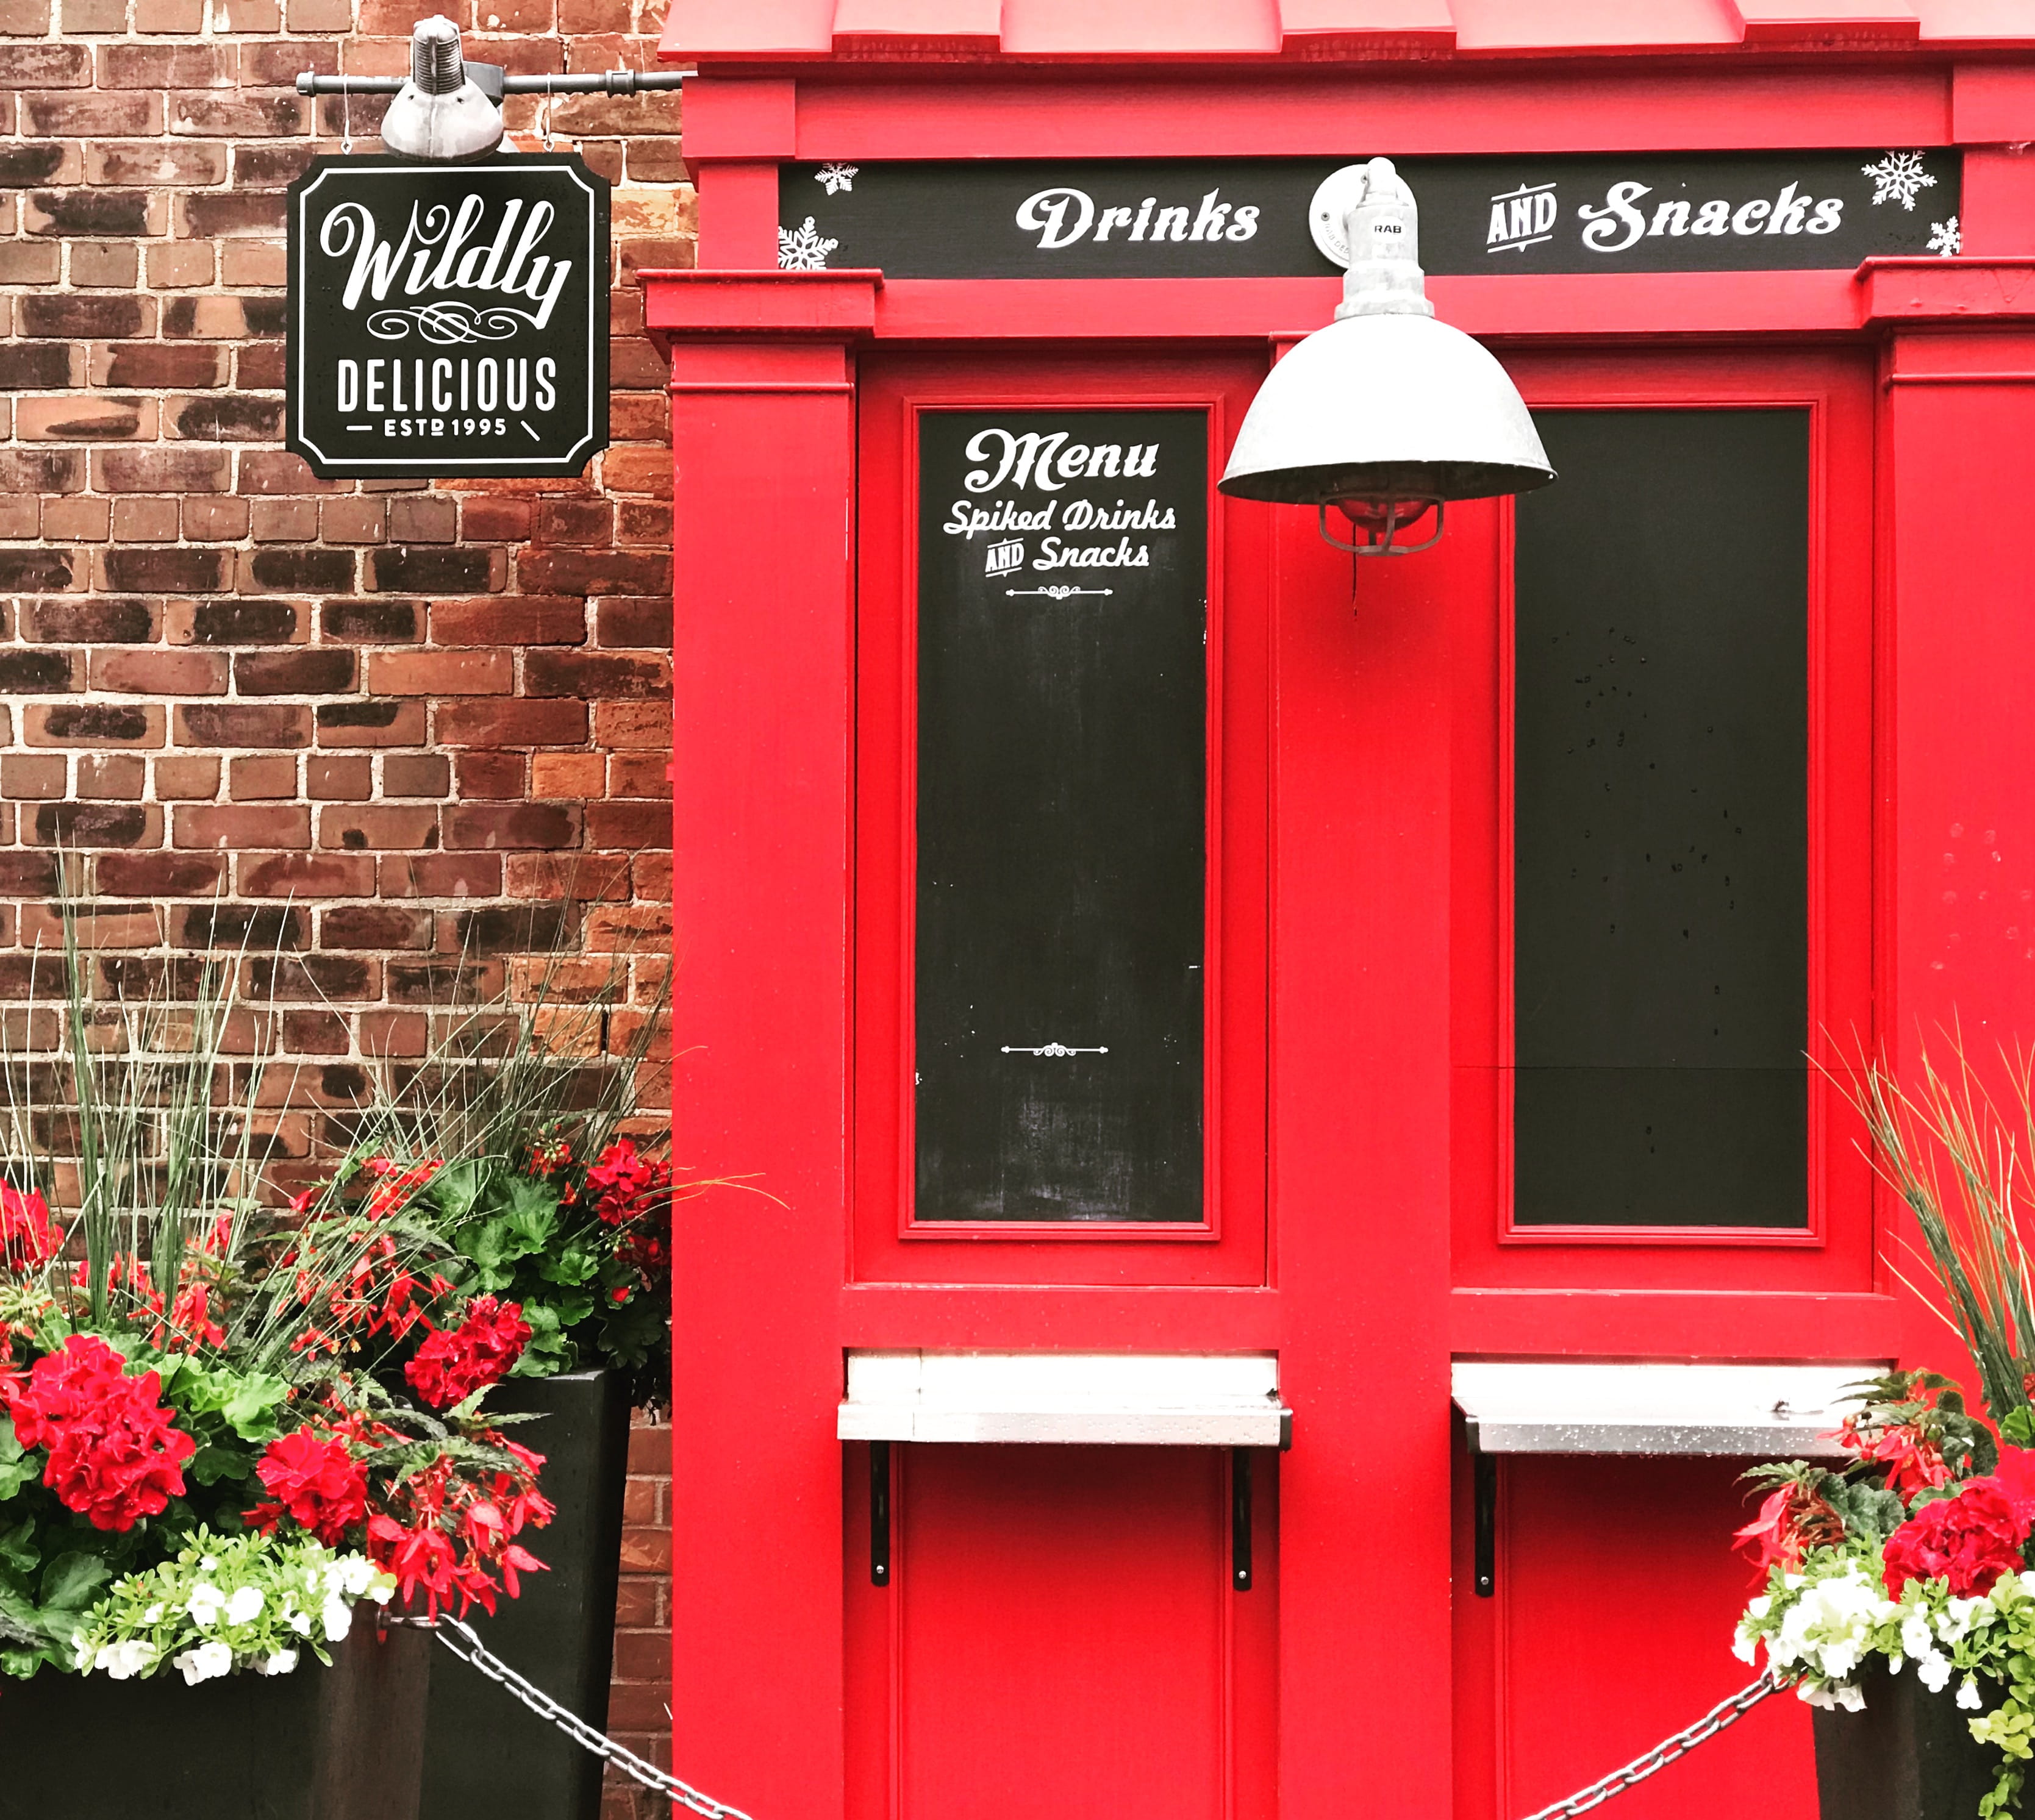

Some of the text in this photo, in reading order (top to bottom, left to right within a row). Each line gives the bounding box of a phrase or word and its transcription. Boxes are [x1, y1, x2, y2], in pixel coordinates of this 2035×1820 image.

[1016, 181, 1844, 252] Drinks AND Snacks
[320, 194, 572, 330] Wildly
[338, 357, 556, 412] DELICIOUS
[385, 418, 506, 436] ESTD 1995
[964, 429, 1159, 493] Menu
[943, 499, 1176, 540] Spiked Drinks
[985, 537, 1150, 573] AND Snacks
